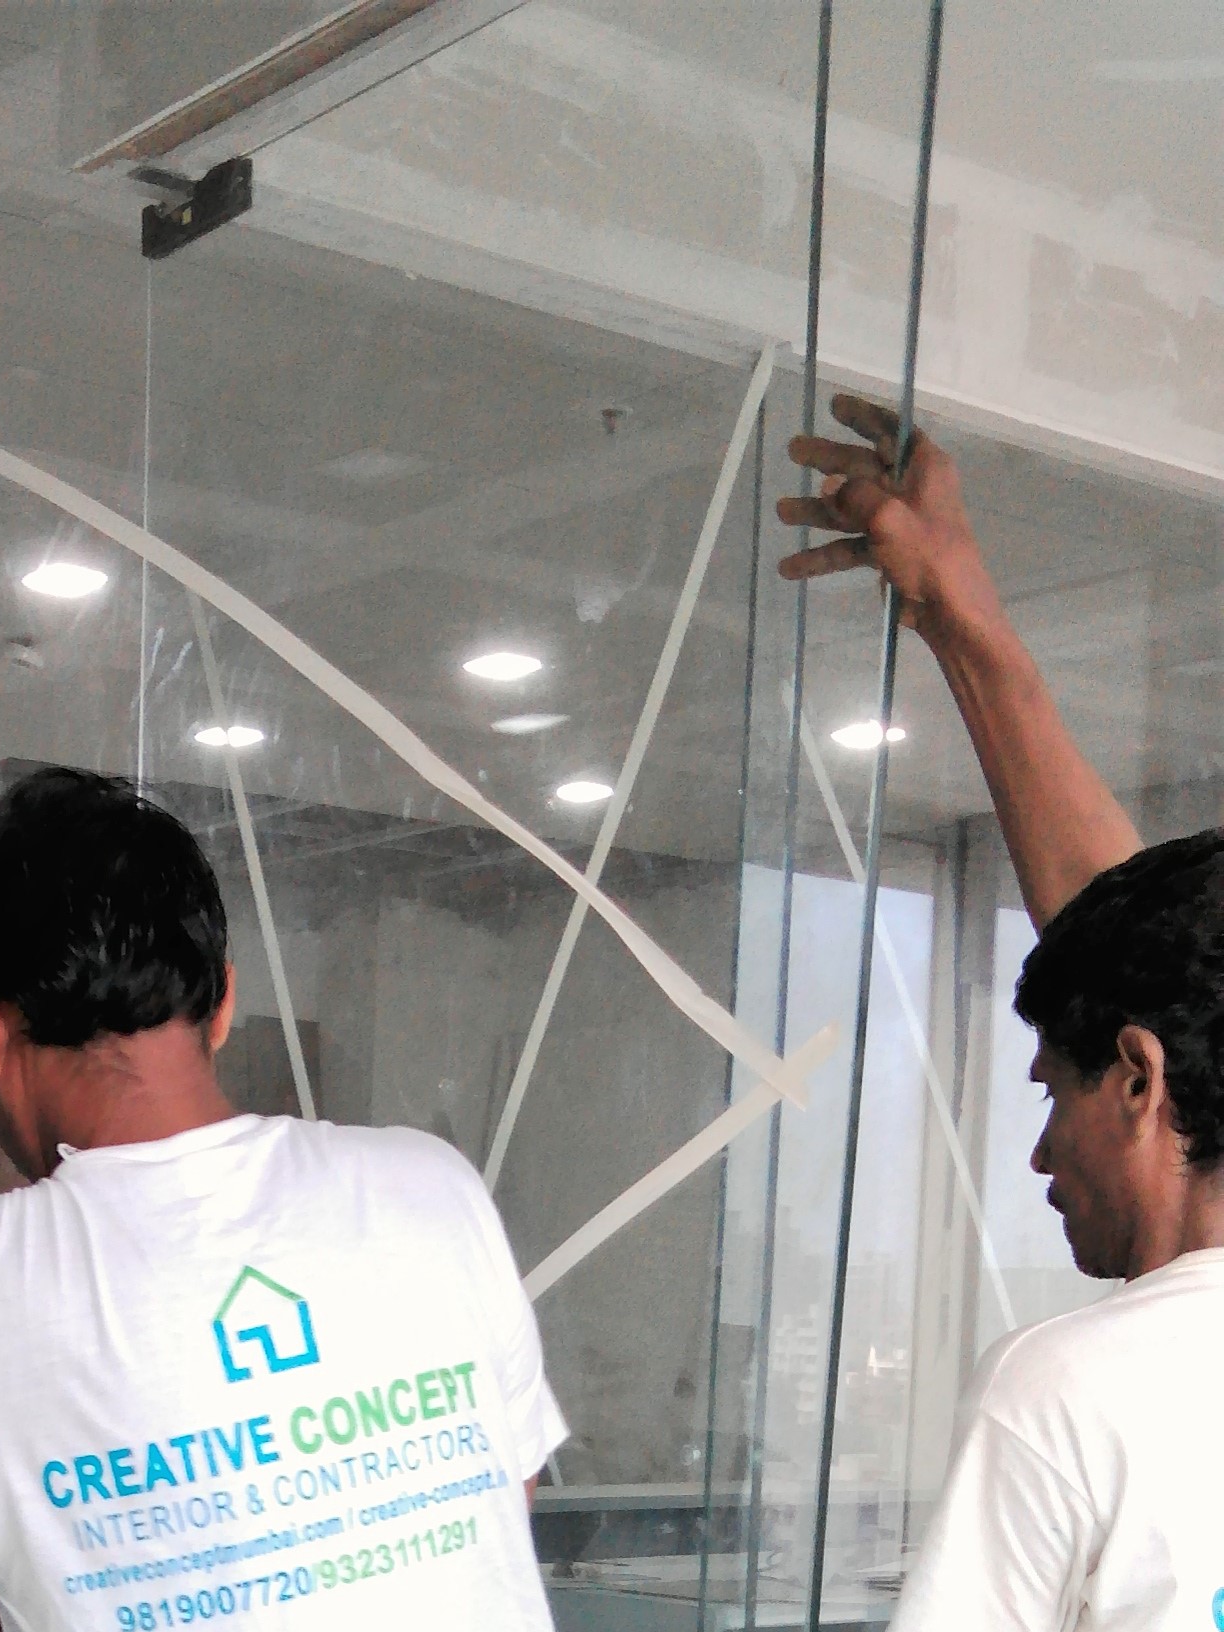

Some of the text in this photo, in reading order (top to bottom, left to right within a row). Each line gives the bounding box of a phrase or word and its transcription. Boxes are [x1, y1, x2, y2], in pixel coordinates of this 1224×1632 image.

[42, 1361, 477, 1508] CREATIVE CONCEPT
[73, 1422, 490, 1551] INTERIOR & CONTRACTORS
